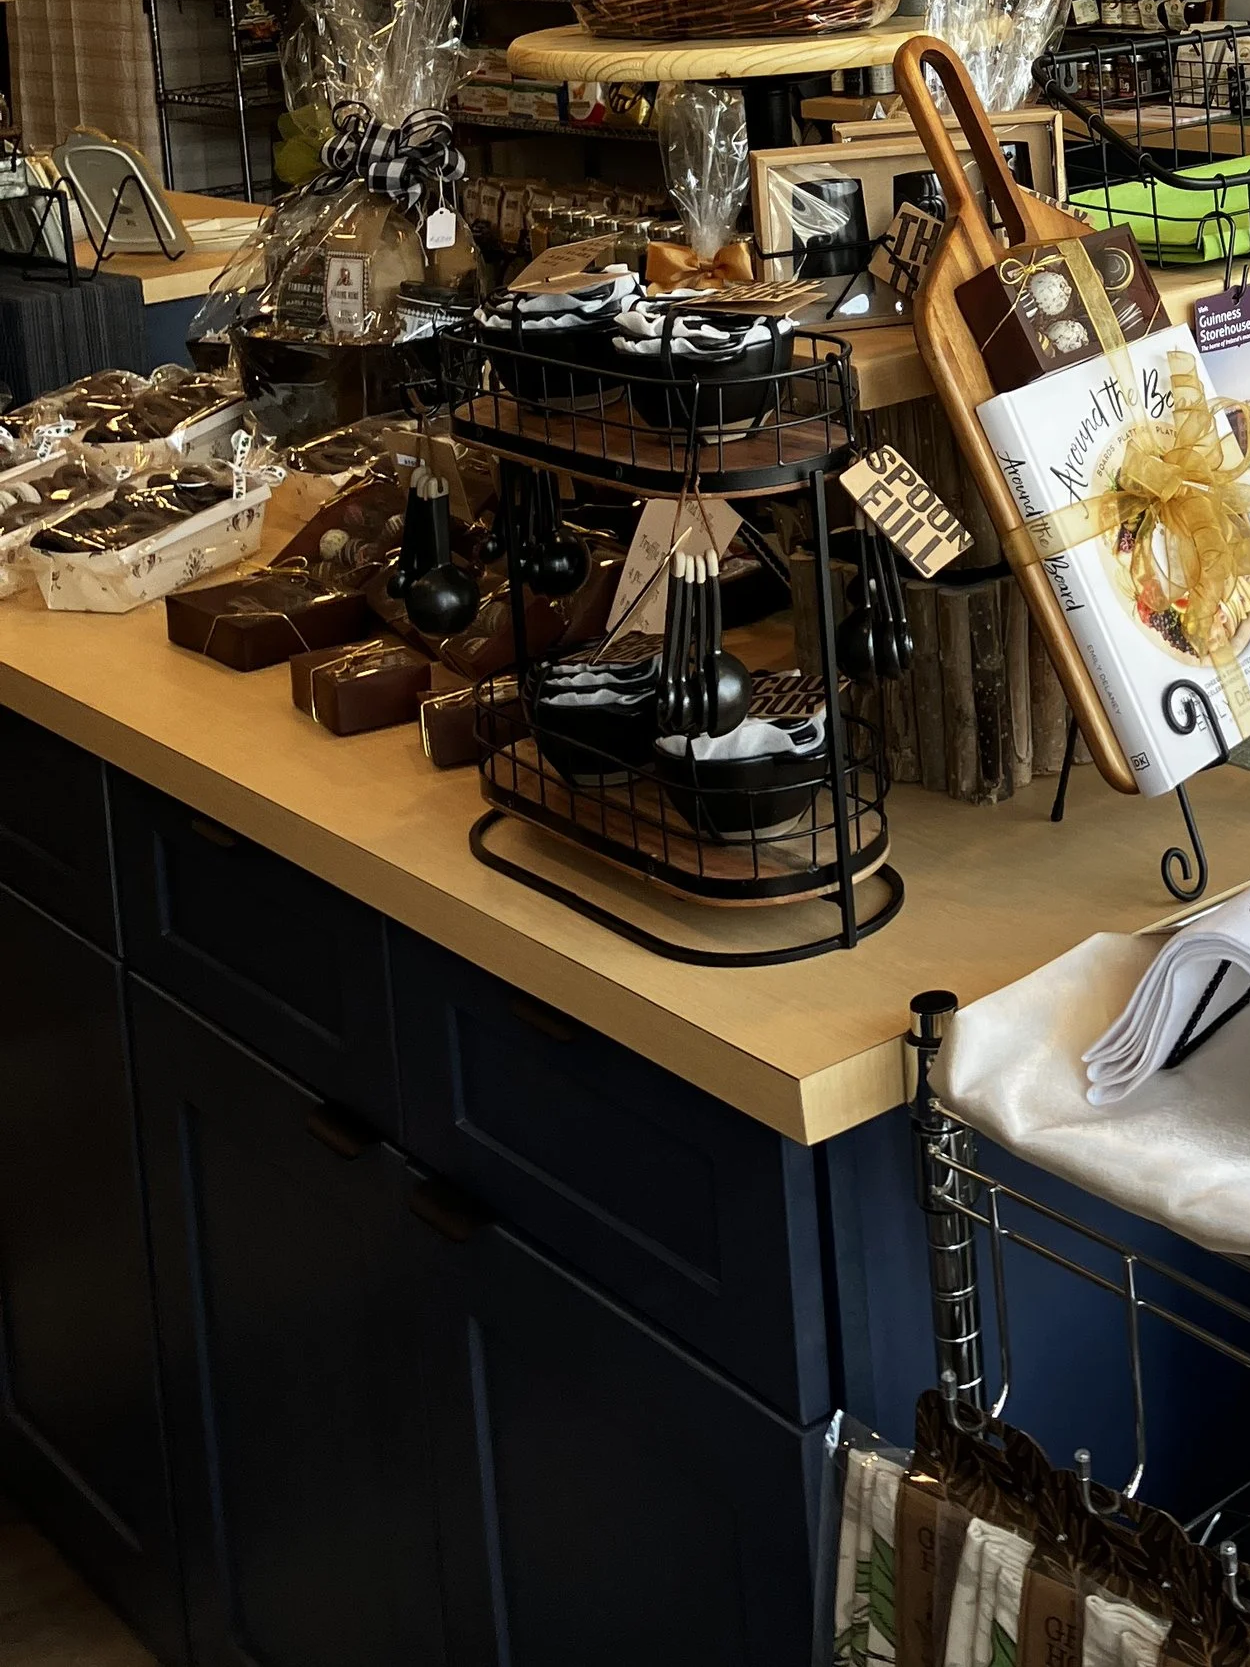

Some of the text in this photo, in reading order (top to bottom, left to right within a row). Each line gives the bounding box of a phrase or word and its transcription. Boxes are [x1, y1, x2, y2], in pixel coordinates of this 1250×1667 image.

[1199, 307, 1242, 329] Guinness
[1049, 376, 1139, 520] Around the
[1096, 445, 1116, 478] BOARDS
[857, 480, 944, 576] FULL
[866, 446, 976, 553] SPOON
[997, 450, 1085, 613] Around the Board
[1097, 672, 1122, 716] DELANEY
[1131, 753, 1148, 770] DK
